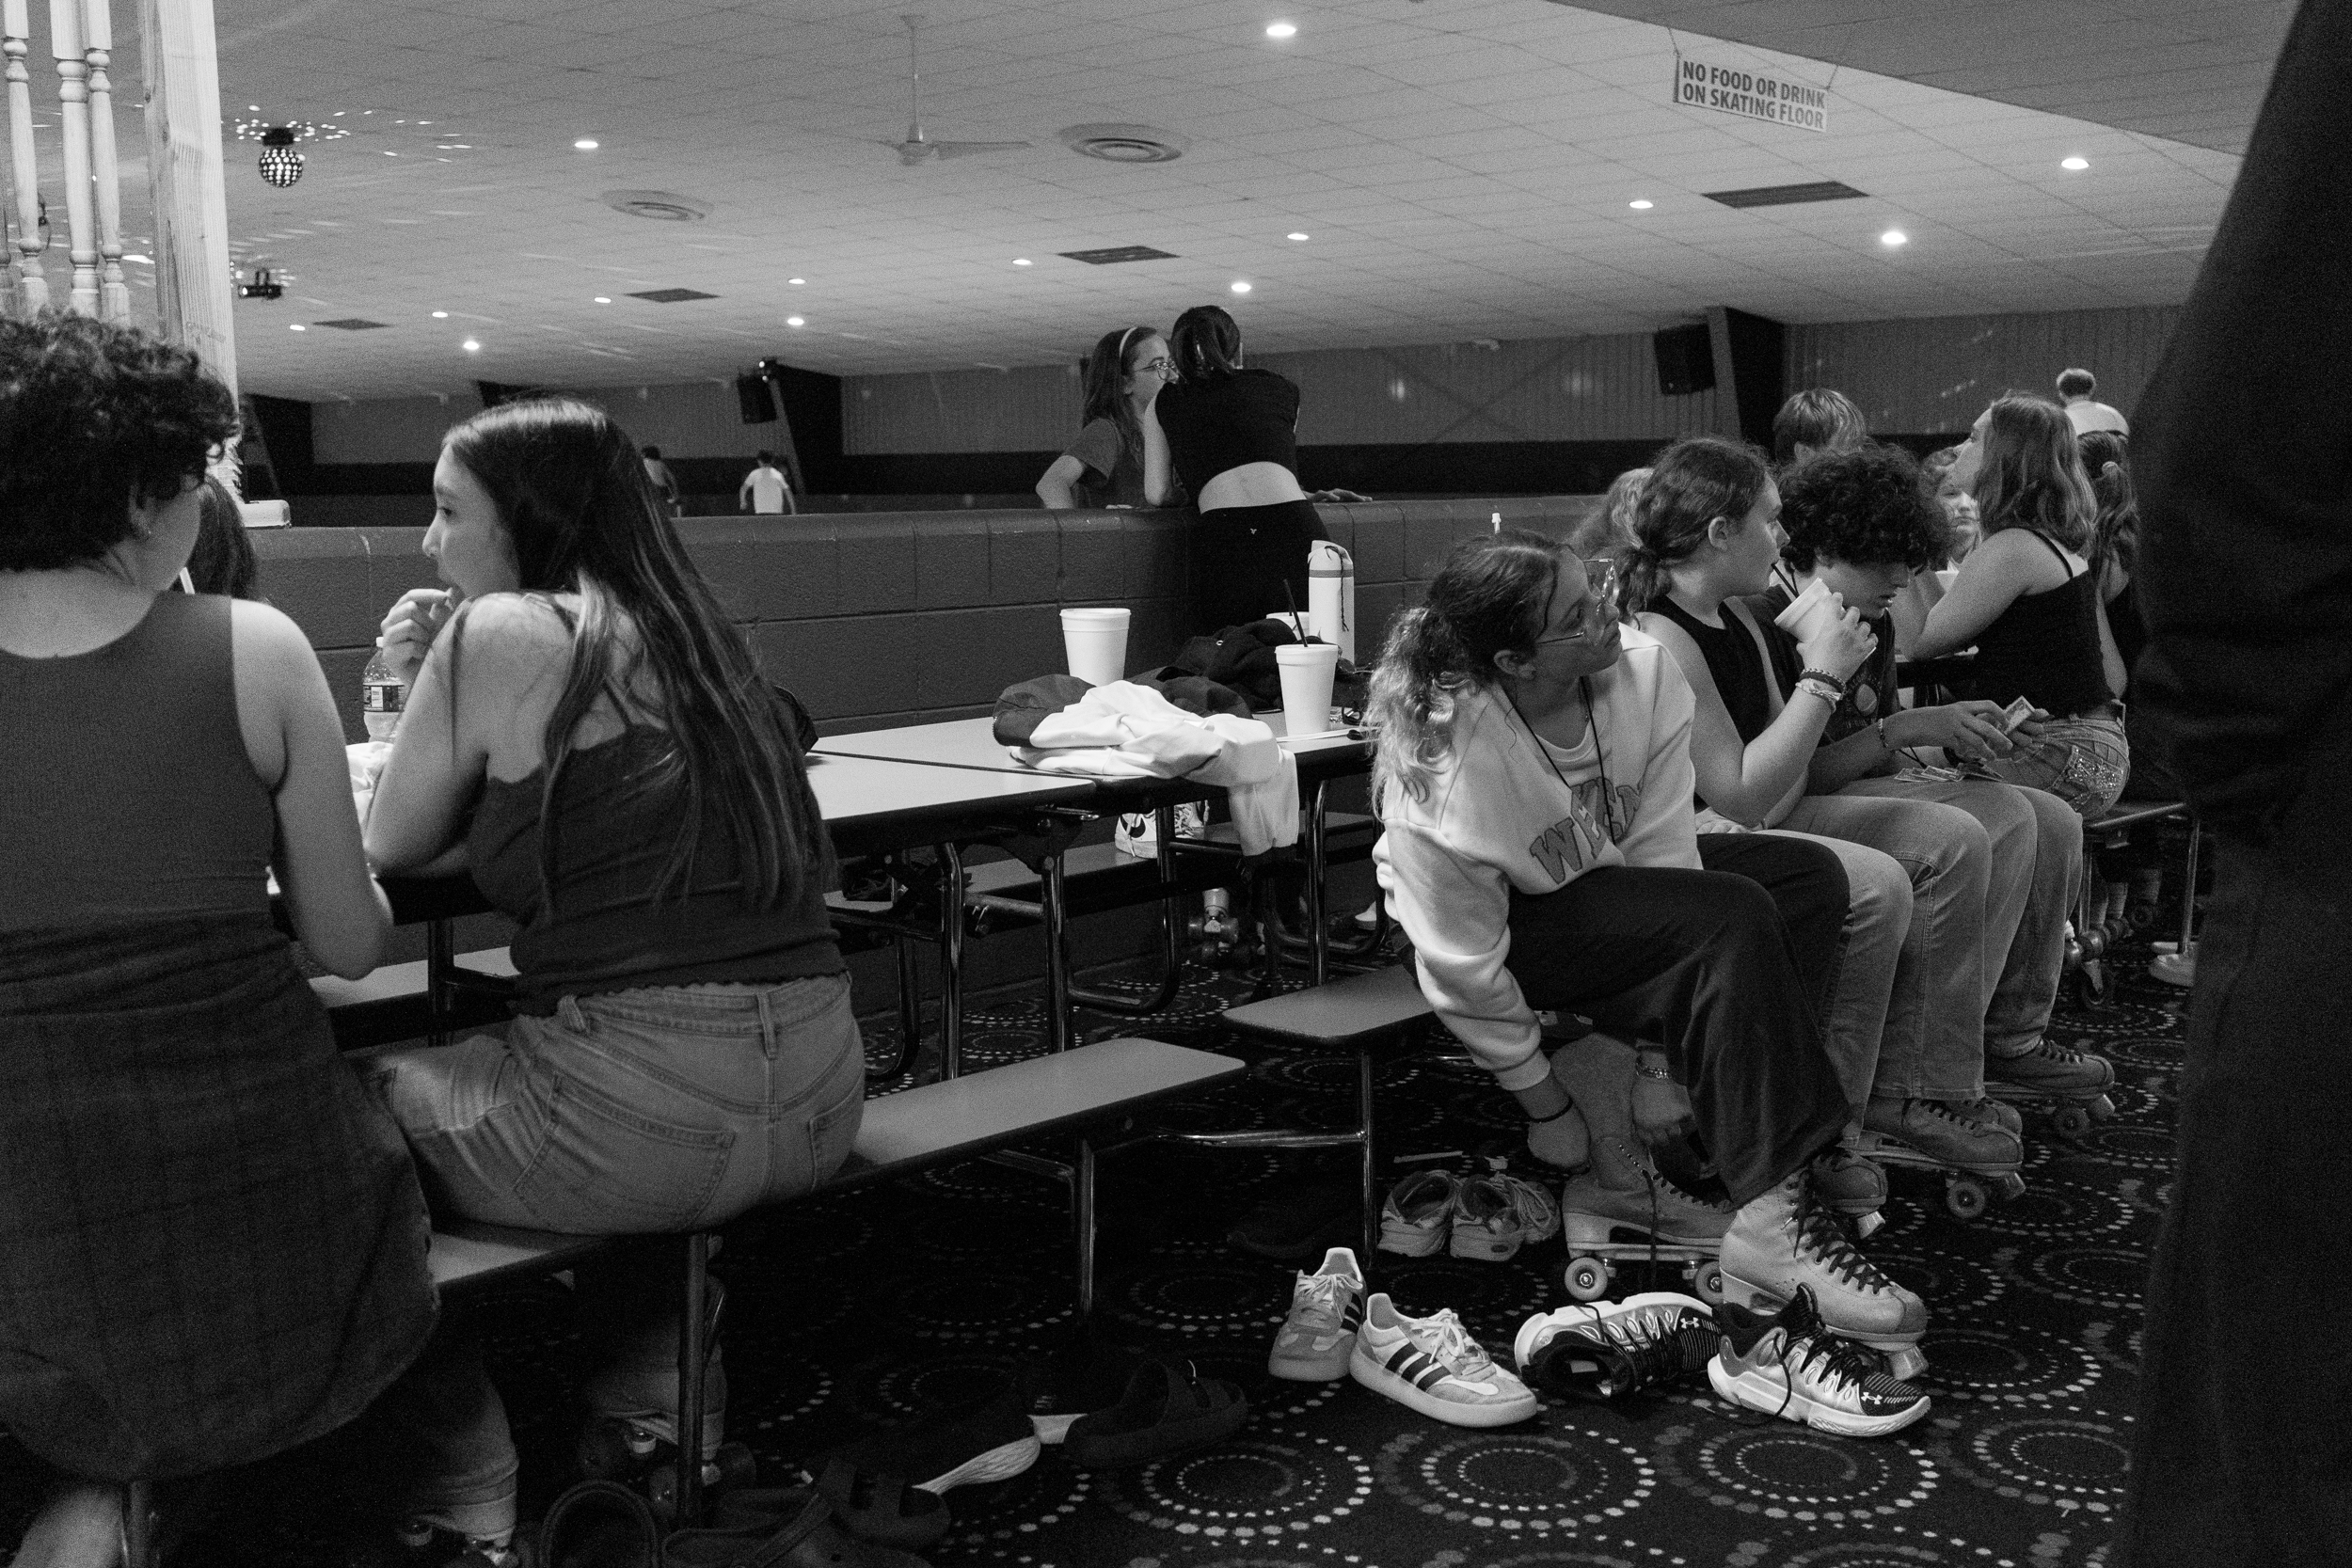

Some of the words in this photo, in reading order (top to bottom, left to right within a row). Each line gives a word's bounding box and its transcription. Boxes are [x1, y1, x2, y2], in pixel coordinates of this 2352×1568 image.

[1683, 60, 1706, 82] NO
[1710, 67, 1753, 92] FOOD
[1756, 77, 1776, 98] OR
[1780, 83, 1825, 109] DRINK
[1683, 83, 1706, 103] ON
[1710, 88, 1775, 119] SKATING
[1779, 103, 1824, 129] FLOOR
